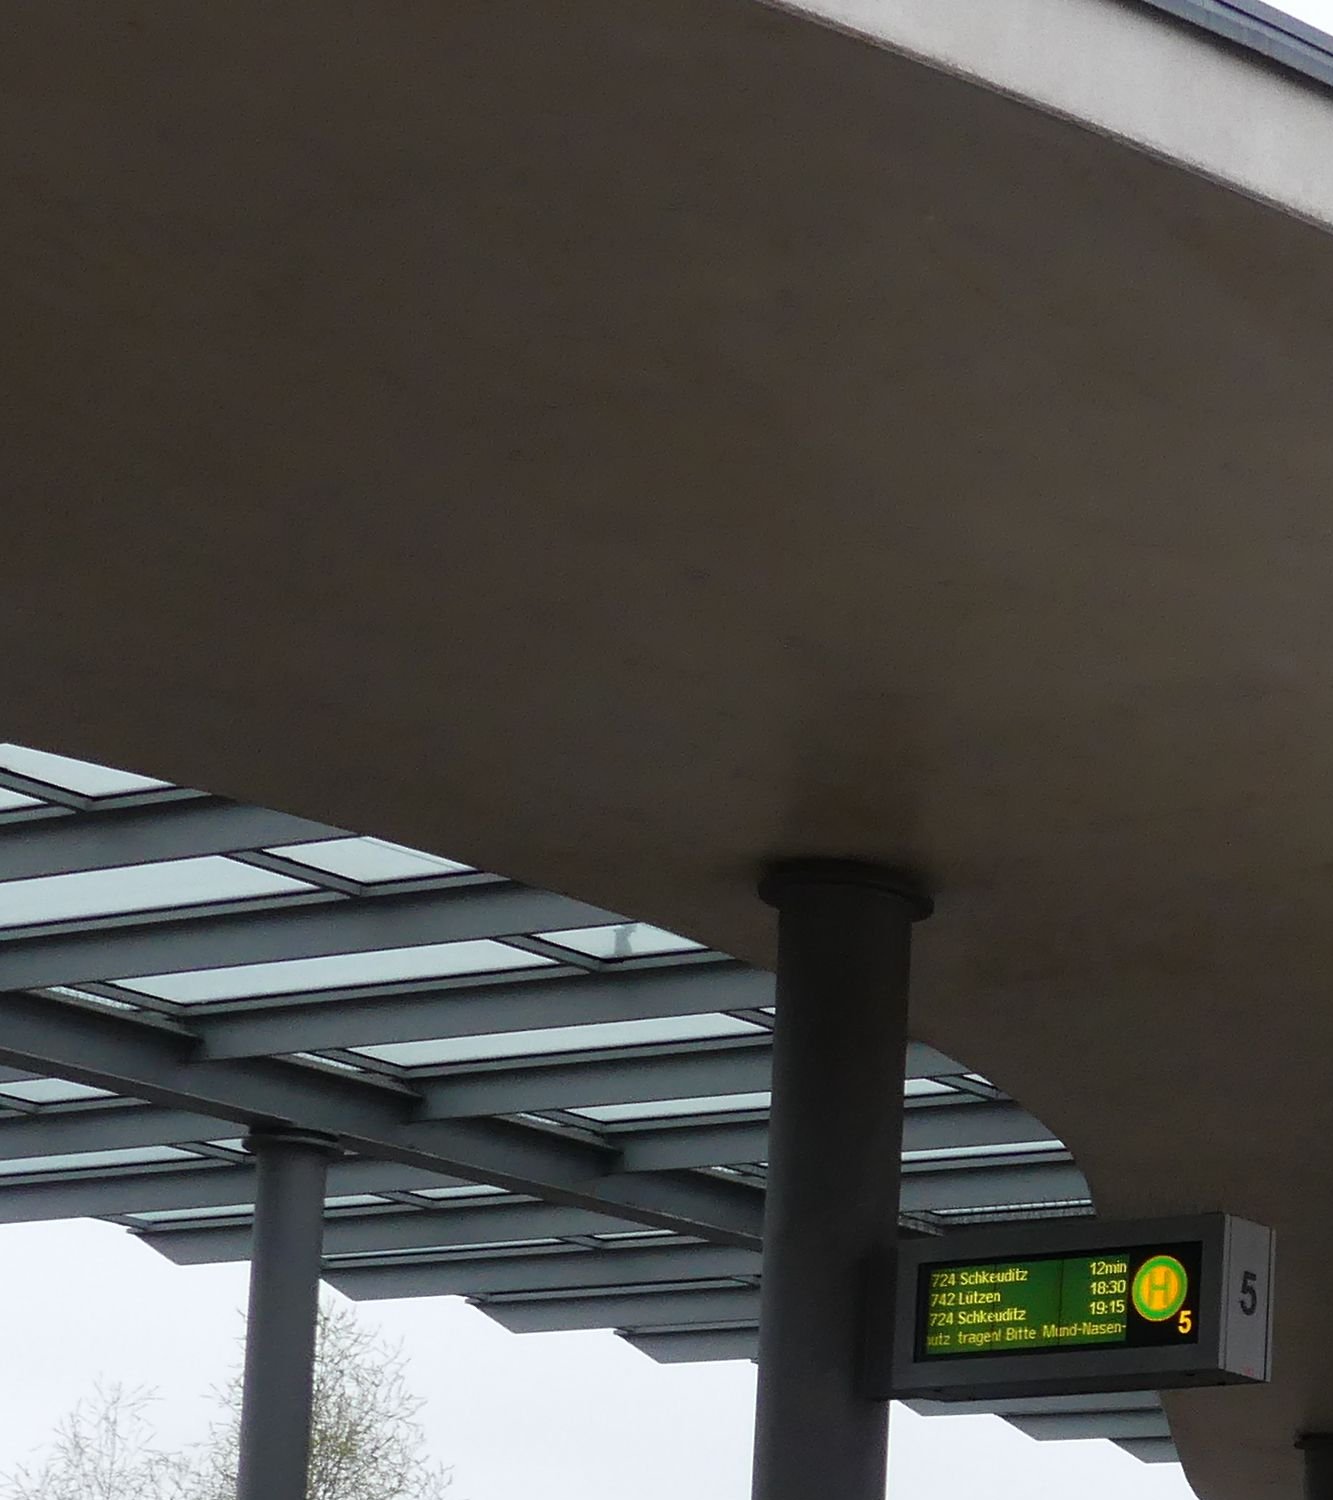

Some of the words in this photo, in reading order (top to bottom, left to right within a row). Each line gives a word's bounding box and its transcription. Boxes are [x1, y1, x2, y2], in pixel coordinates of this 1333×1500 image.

[931, 1273, 956, 1288] 724
[960, 1268, 1028, 1286] Schkeuditz
[1089, 1260, 1127, 1276] 12min
[931, 1292, 956, 1308] 742
[958, 1290, 1001, 1305] Lützen
[1090, 1280, 1127, 1295] 18:30
[1240, 1271, 1258, 1316] 5
[929, 1312, 954, 1327] 724
[958, 1307, 1027, 1325] Schkeuditz
[1089, 1301, 1125, 1315] 19:15
[1177, 1310, 1192, 1334] 5
[1006, 1326, 1037, 1341] Bitte
